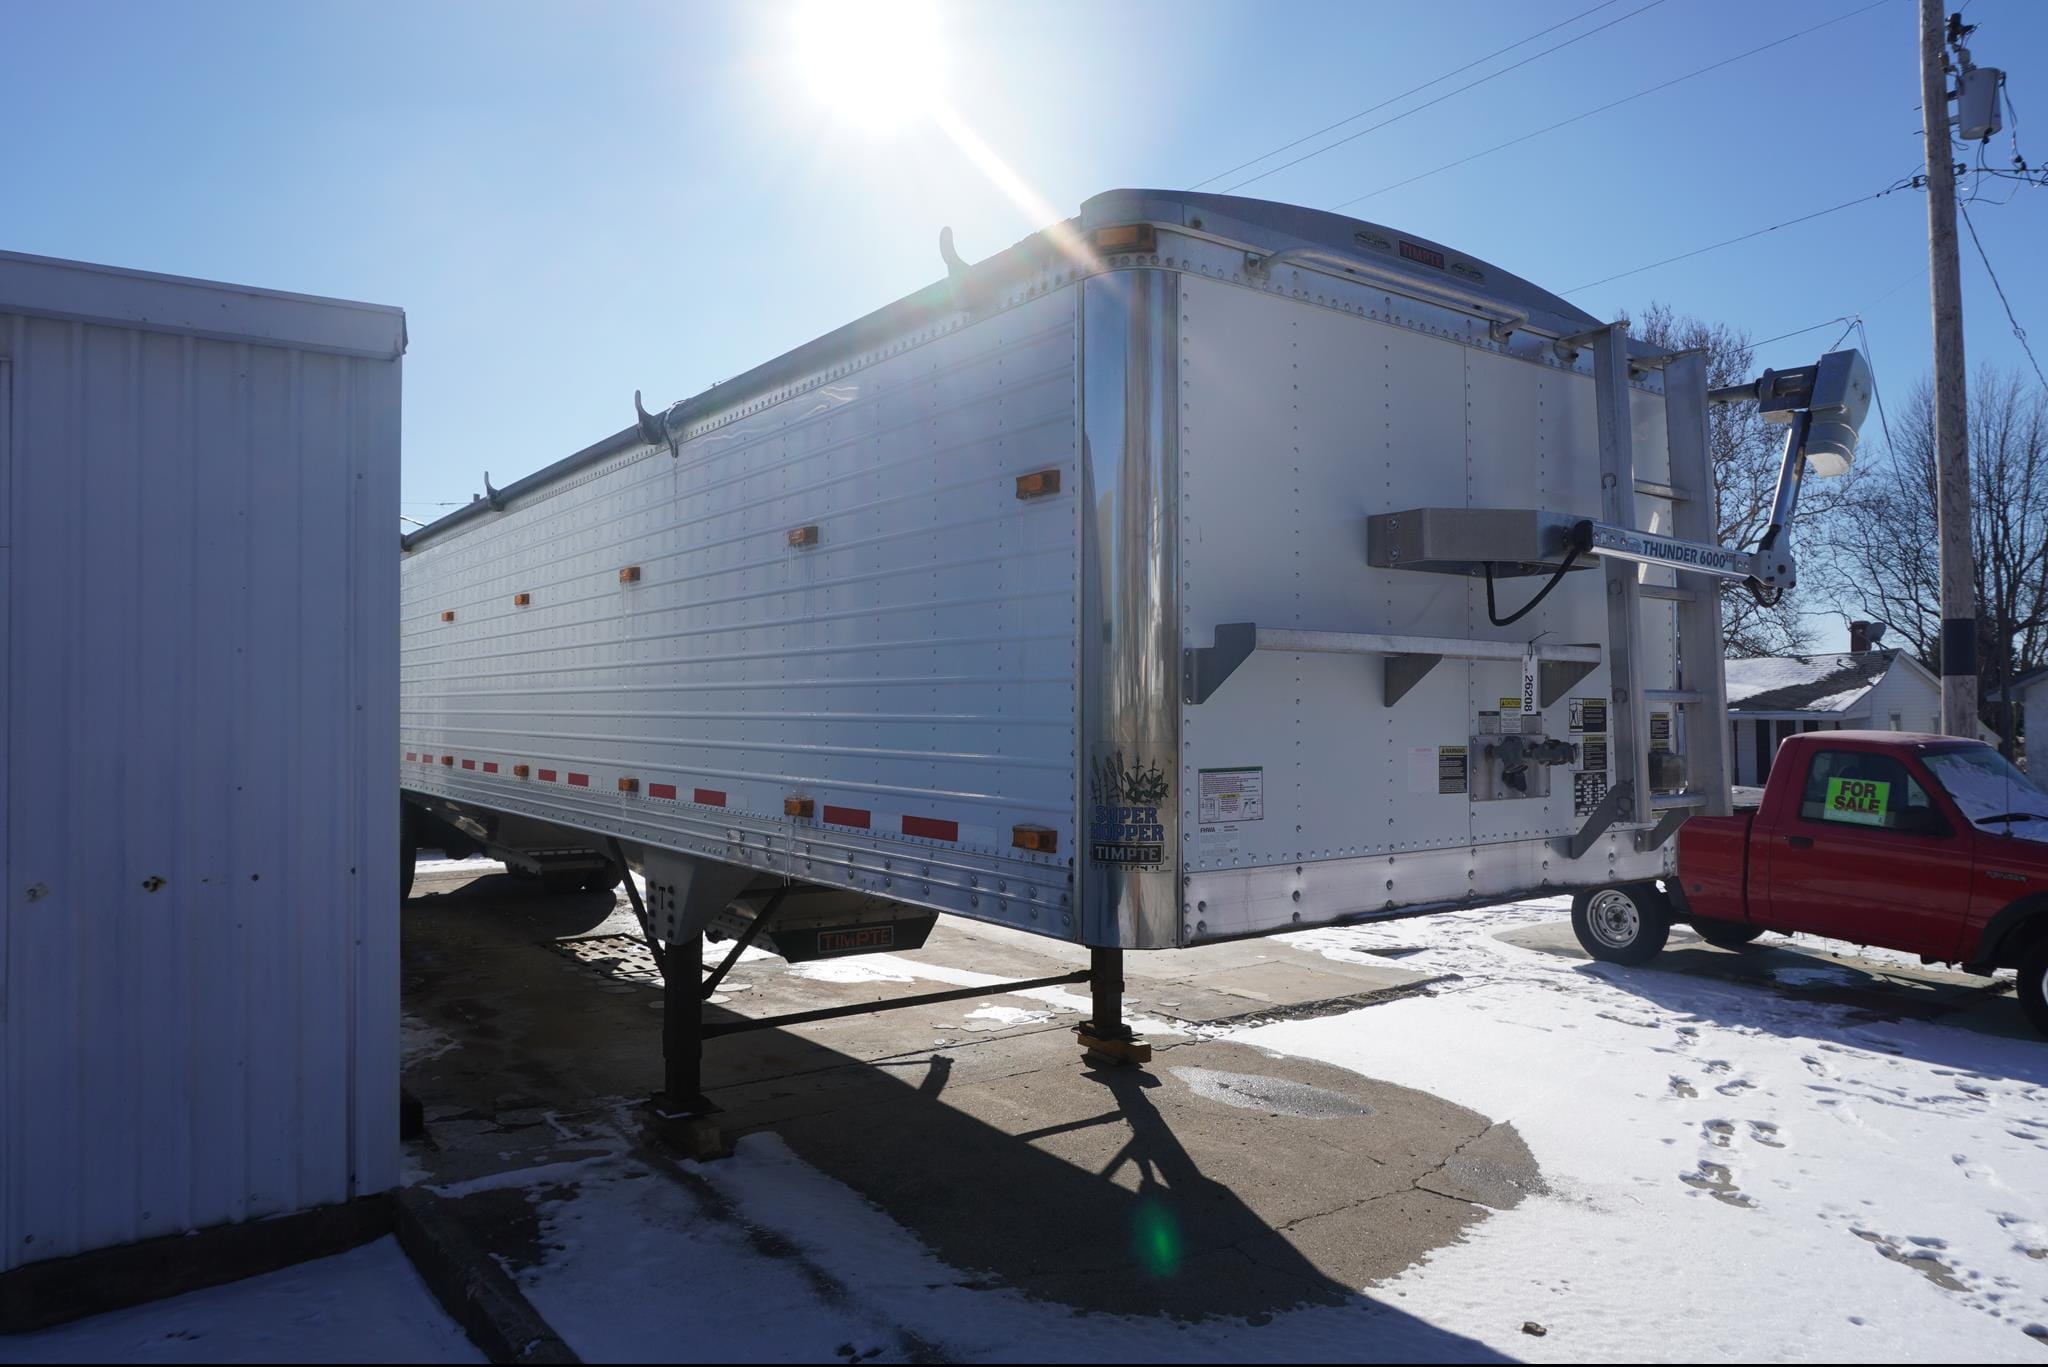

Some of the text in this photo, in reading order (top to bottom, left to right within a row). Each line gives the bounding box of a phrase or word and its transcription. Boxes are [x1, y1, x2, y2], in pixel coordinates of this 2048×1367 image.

[1401, 243, 1445, 268] TIMPTE
[1643, 540, 1698, 563] THUNDER
[1700, 550, 1726, 568] 6000
[1524, 675, 1534, 712] 26208
[1840, 780, 1877, 799] FOR
[1833, 795, 1881, 813] SALE
[1095, 805, 1158, 824] SUPER
[1090, 822, 1165, 841] HOPPER
[1095, 846, 1160, 861] TIMPTE
[822, 929, 890, 949] TIMPTE
